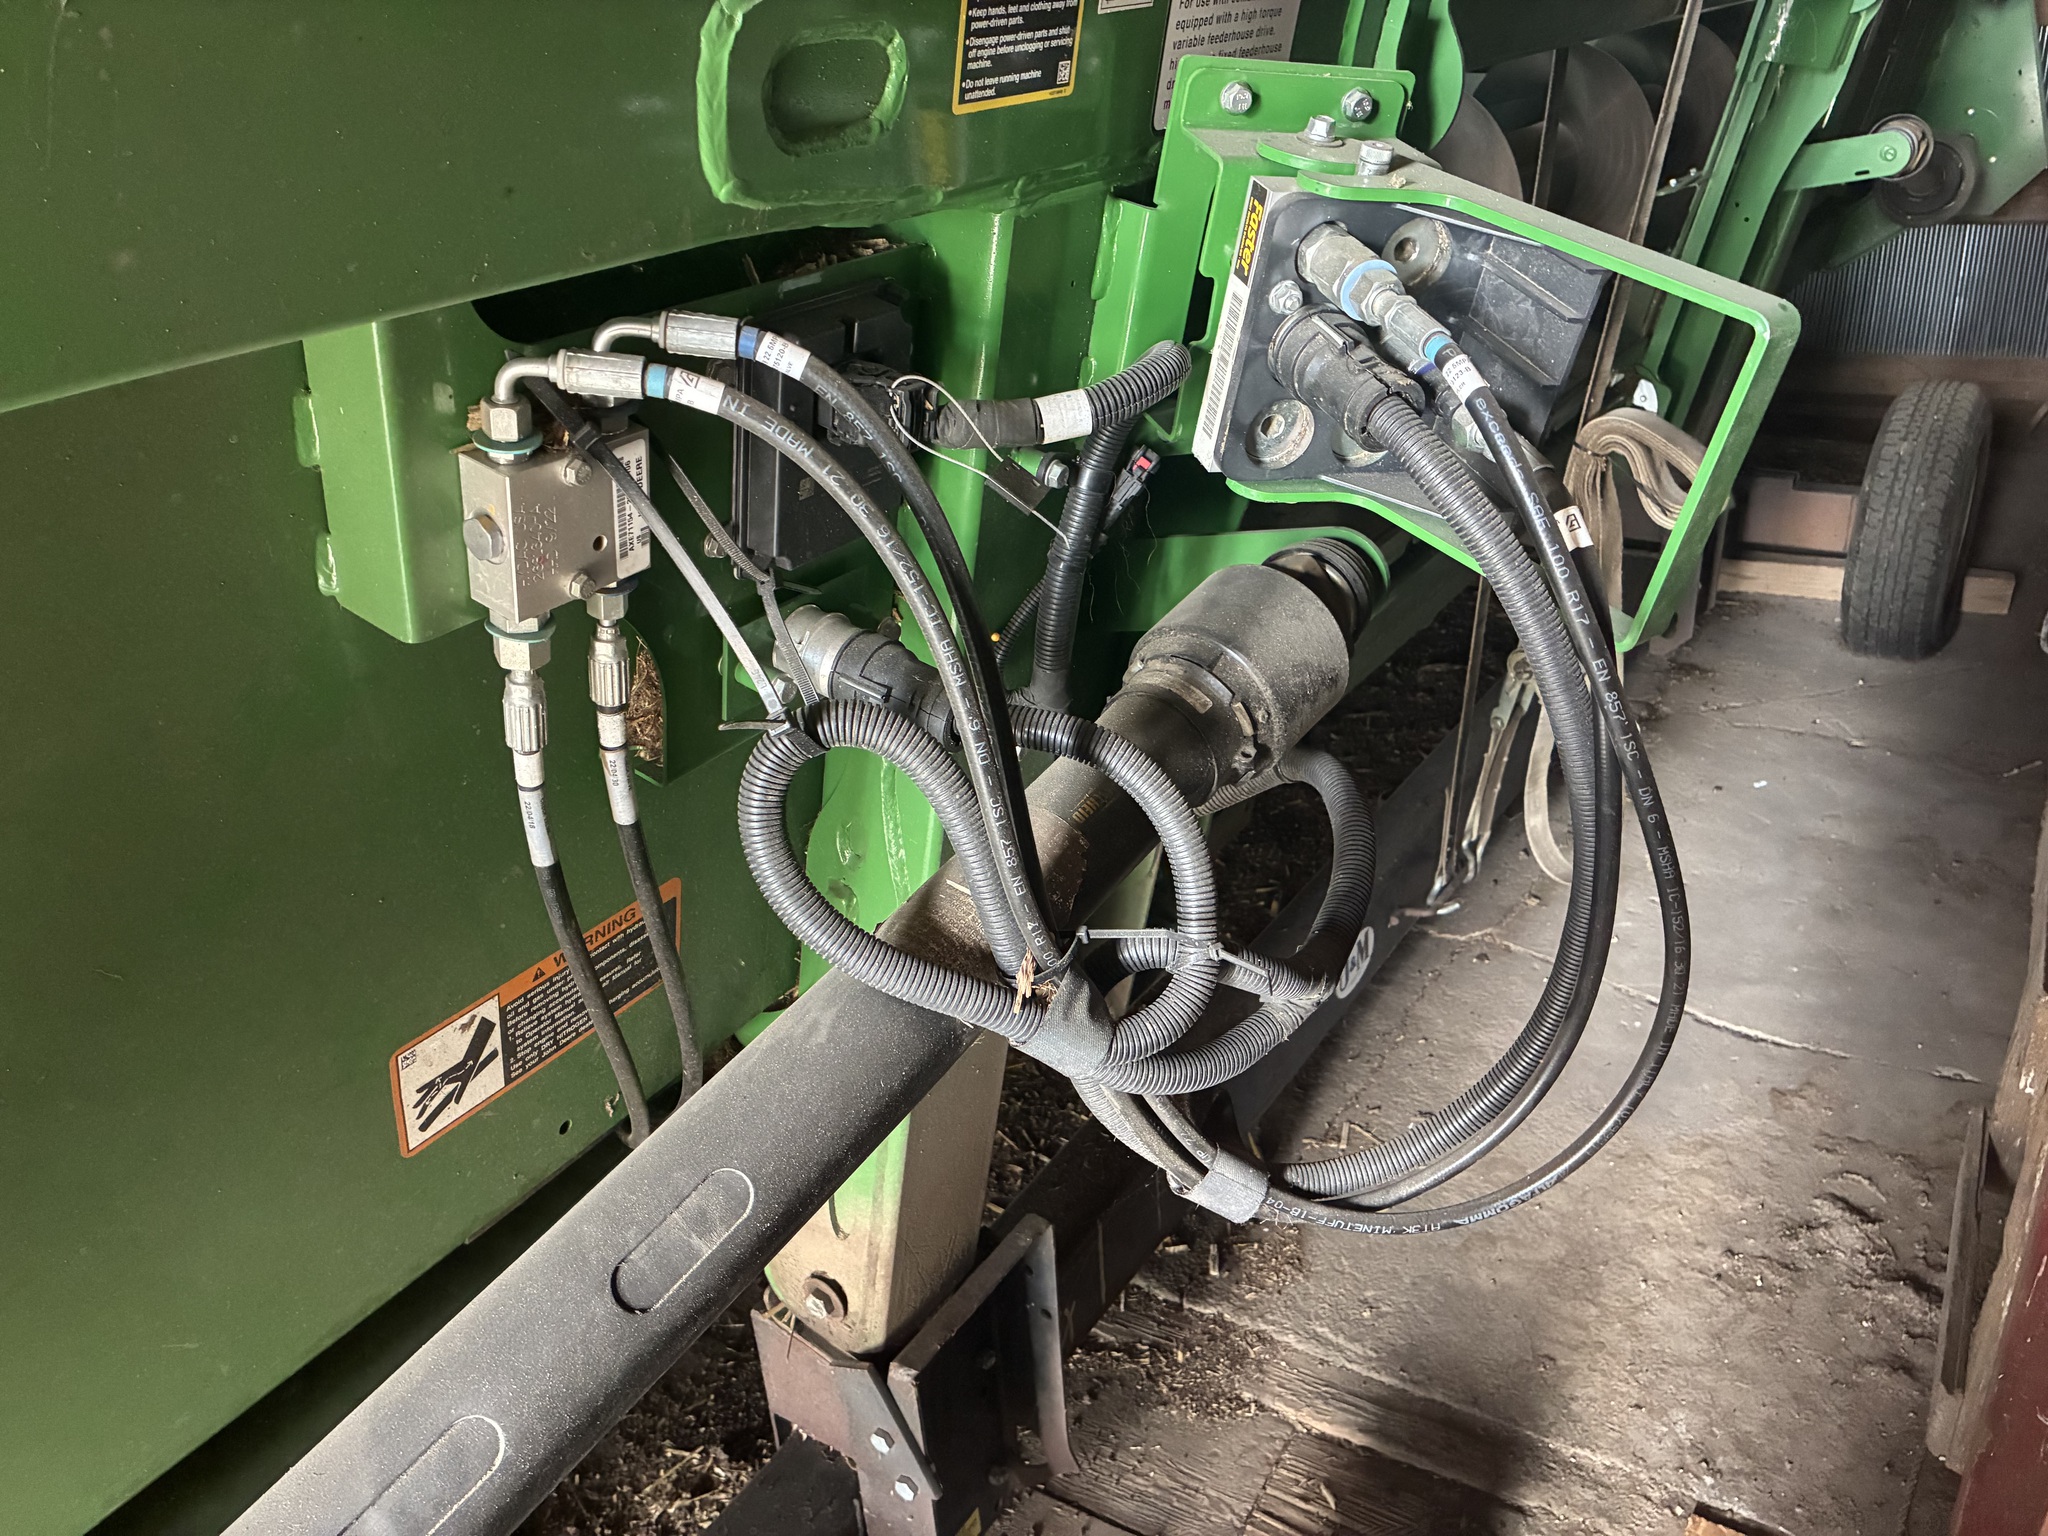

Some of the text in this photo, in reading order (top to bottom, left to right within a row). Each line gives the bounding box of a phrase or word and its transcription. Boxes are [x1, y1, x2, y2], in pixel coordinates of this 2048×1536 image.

[972, 8, 987, 18] Keep
[1008, 4, 1018, 13] feet
[1020, 2, 1029, 12] and
[1030, 1, 1051, 11] clothing
[1052, 1, 1065, 10] away
[1179, 0, 1193, 9] For
[971, 16, 1024, 31] power-driven parts.
[1175, 7, 1282, 31] equipped with a high torque
[968, 49, 977, 58] off
[977, 47, 995, 58] engine
[997, 44, 1013, 54] before
[1015, 40, 1043, 52] unclogging
[1051, 37, 1073, 47] servicing
[970, 36, 998, 47] Disengage
[1000, 31, 1033, 45] power-driven
[1034, 29, 1047, 40] parts
[1049, 27, 1058, 36] and
[1173, 25, 1275, 50] variable feederhouse drive.
[1239, 43, 1282, 57] feederhouse
[967, 60, 992, 70] machine.
[966, 70, 1041, 89] Do not leave running machine
[965, 88, 996, 100] unattended.
[1243, 199, 1263, 276] Faster
[722, 395, 751, 417] IN
[764, 415, 814, 459] MADE
[822, 466, 845, 486] 21
[1549, 543, 1570, 581] 100
[1566, 591, 1591, 626] R17
[940, 640, 967, 688] MSHA
[1592, 660, 1611, 682] EN
[969, 720, 980, 731] 6
[975, 742, 989, 765] DN
[1620, 733, 1640, 761] 1SC
[1638, 788, 1653, 807] DN
[1647, 814, 1660, 823] 6
[1000, 839, 1017, 867] 857
[1658, 846, 1676, 879] MSHA
[1011, 876, 1027, 896] EN
[553, 907, 636, 967] WRNING
[1043, 951, 1060, 968] 00
[507, 996, 523, 1011] Avoid
[527, 981, 548, 998] serious
[516, 1019, 536, 1037] Relieve
[541, 1004, 561, 1021] system
[627, 950, 640, 964] Refer
[518, 1001, 528, 1012] and
[533, 992, 542, 1004] gas
[547, 979, 564, 993] under
[508, 1010, 526, 1027] Before
[531, 990, 558, 1012] removing
[508, 1026, 513, 1035] or
[518, 1007, 544, 1028] changing
[1663, 1002, 1682, 1034] MADE
[516, 1036, 521, 1044] to
[526, 1018, 550, 1038] Operator
[555, 1002, 574, 1019] Manual
[517, 1010, 574, 1052] system information.
[511, 1059, 521, 1071] Use
[526, 1049, 537, 1062] only
[542, 1038, 553, 1050] DRY
[557, 1016, 587, 1040] NITROGEN
[518, 1046, 530, 1059] Stop
[534, 1031, 553, 1048] engine
[557, 1021, 567, 1032] and
[1657, 1040, 1671, 1056] IN
[511, 1067, 521, 1078] See
[526, 1057, 538, 1069] your
[542, 1044, 555, 1058] John
[560, 1031, 575, 1045] Deere
